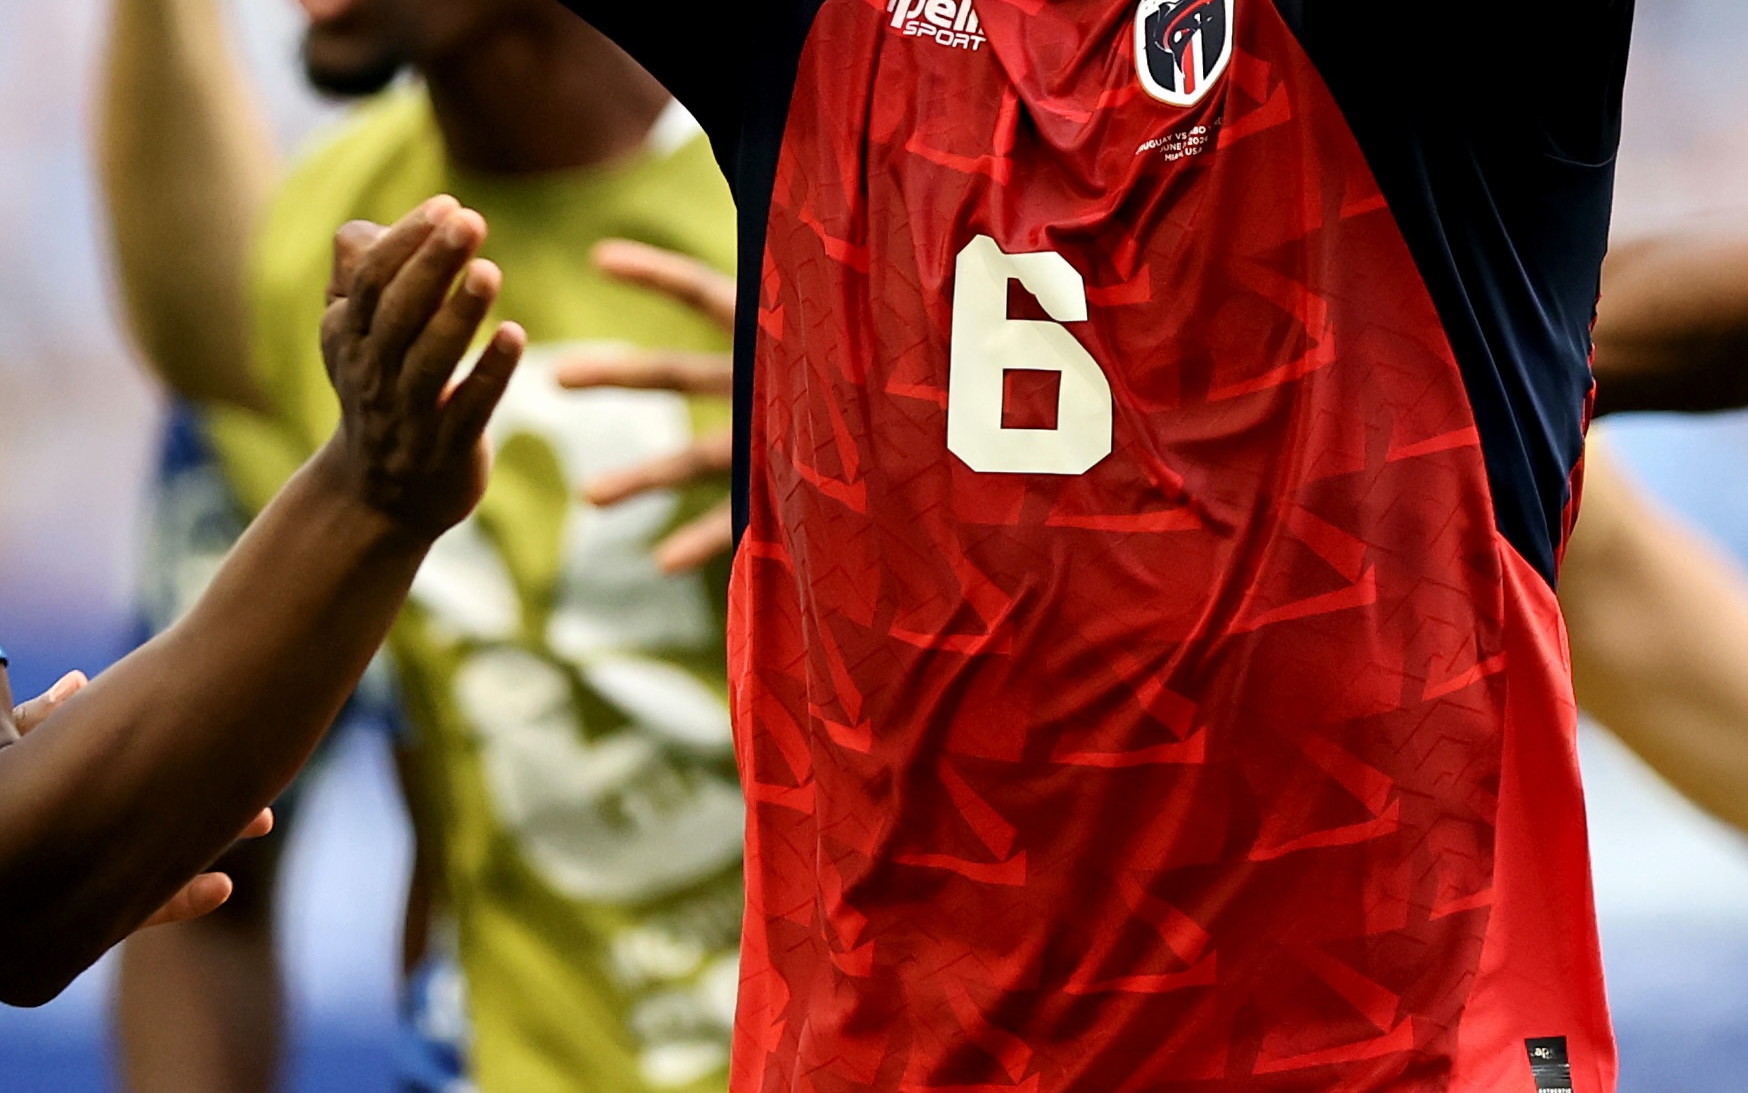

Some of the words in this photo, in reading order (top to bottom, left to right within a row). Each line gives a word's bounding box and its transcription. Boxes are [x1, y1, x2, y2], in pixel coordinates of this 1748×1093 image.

[902, 20, 987, 51] SPORT
[1175, 132, 1187, 140] VS
[1160, 142, 1182, 153] JUNE
[947, 233, 1113, 475] 6
